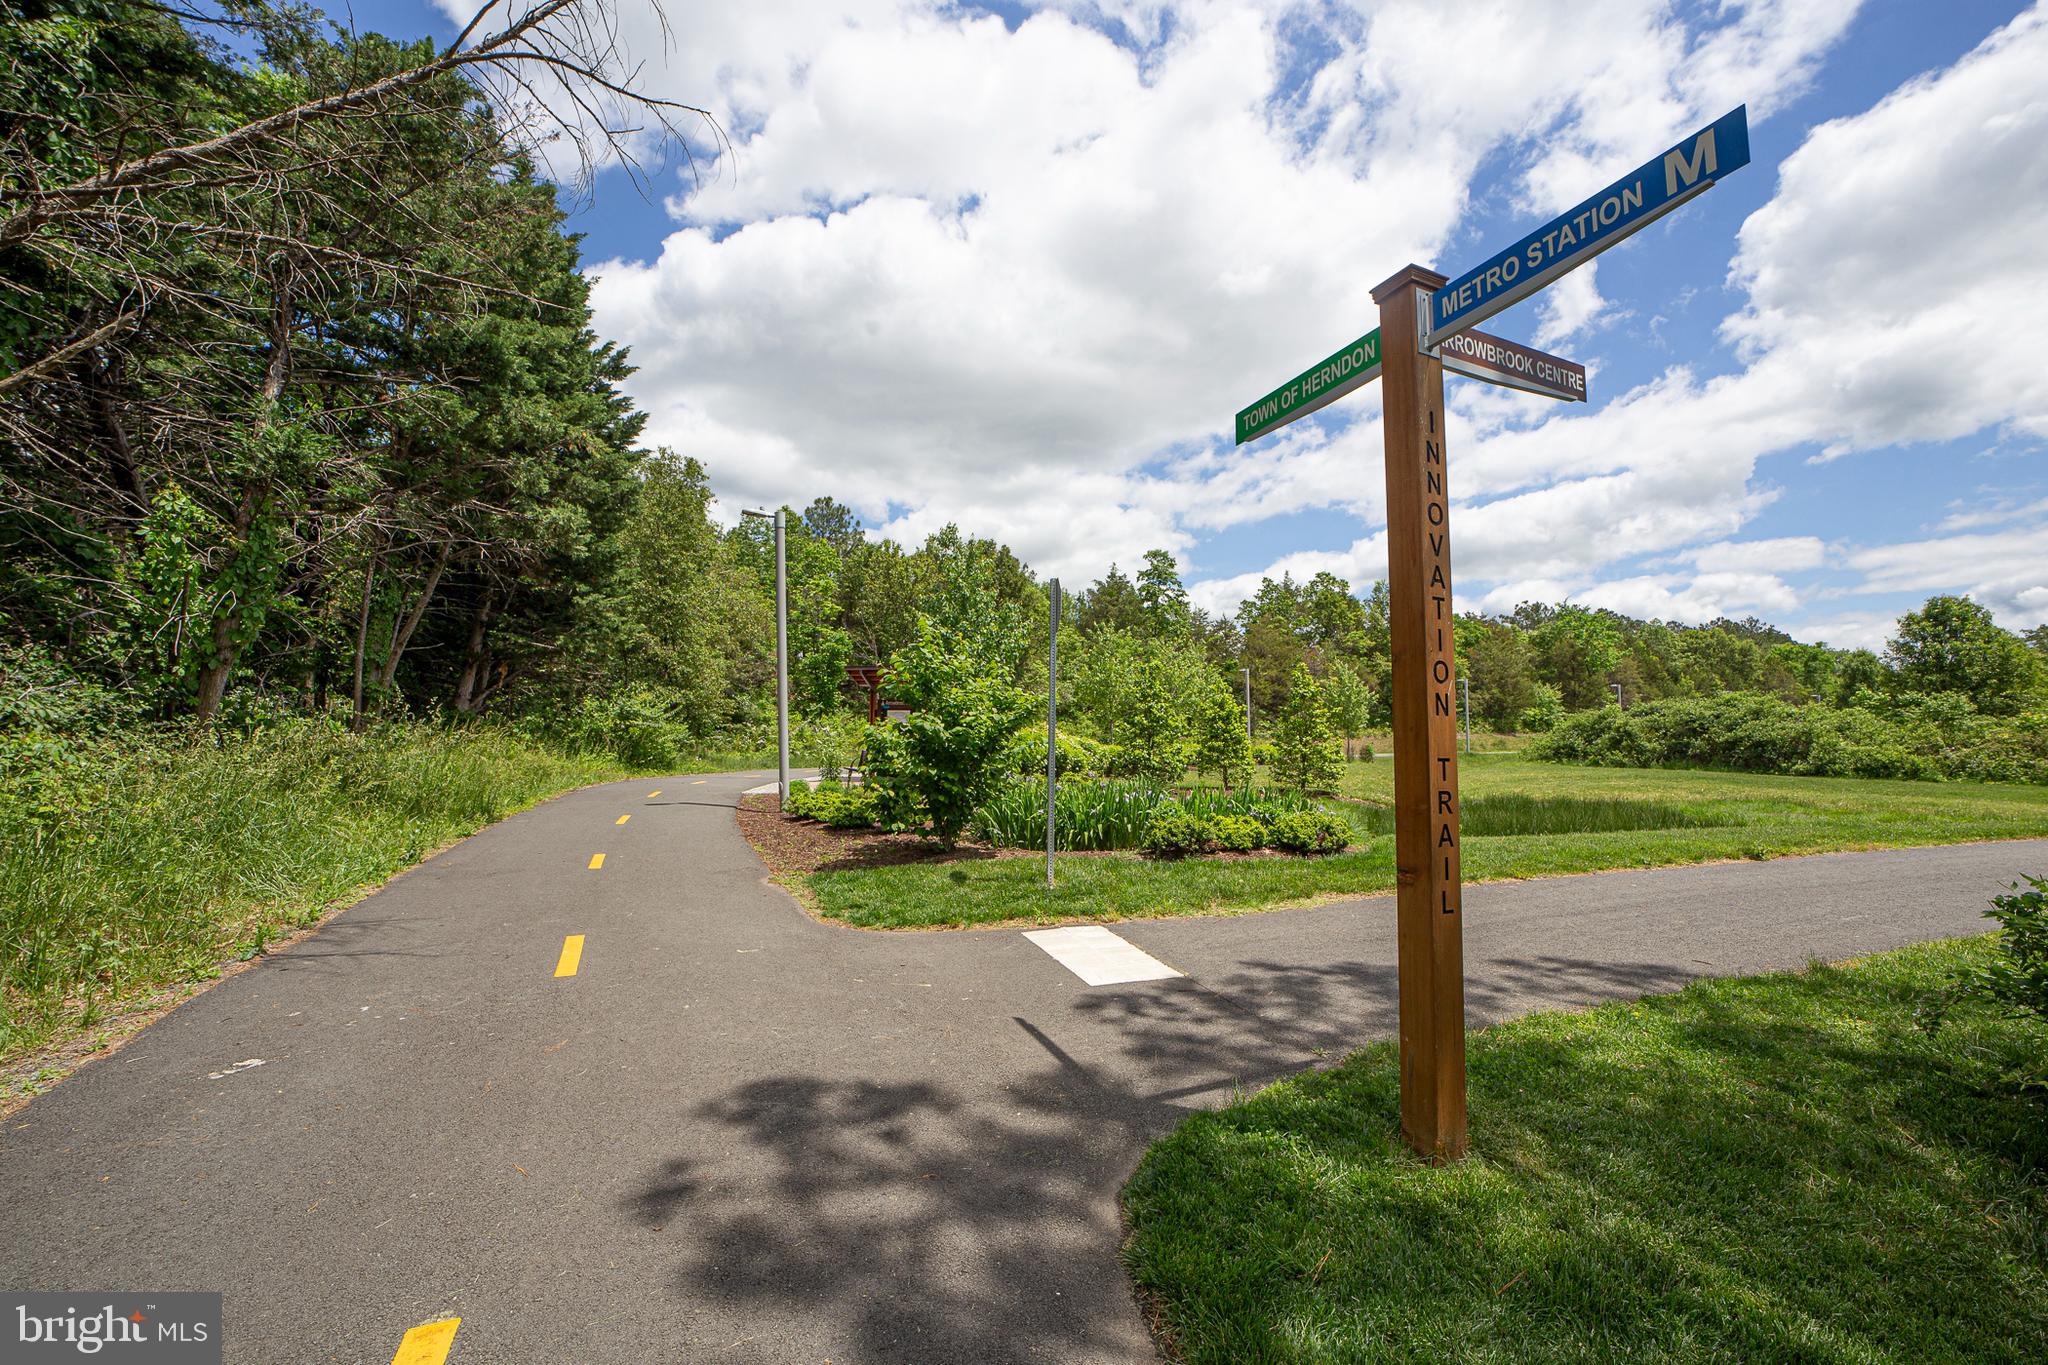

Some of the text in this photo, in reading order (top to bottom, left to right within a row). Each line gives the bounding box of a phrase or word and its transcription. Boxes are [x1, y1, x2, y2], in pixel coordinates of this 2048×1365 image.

[1442, 127, 1718, 319] METRO STATION M
[1243, 338, 1376, 431] TOWN OF HERNDON
[1536, 360, 1584, 393] CENTRE
[1426, 410, 1455, 915] INNOVATION TRAIL
